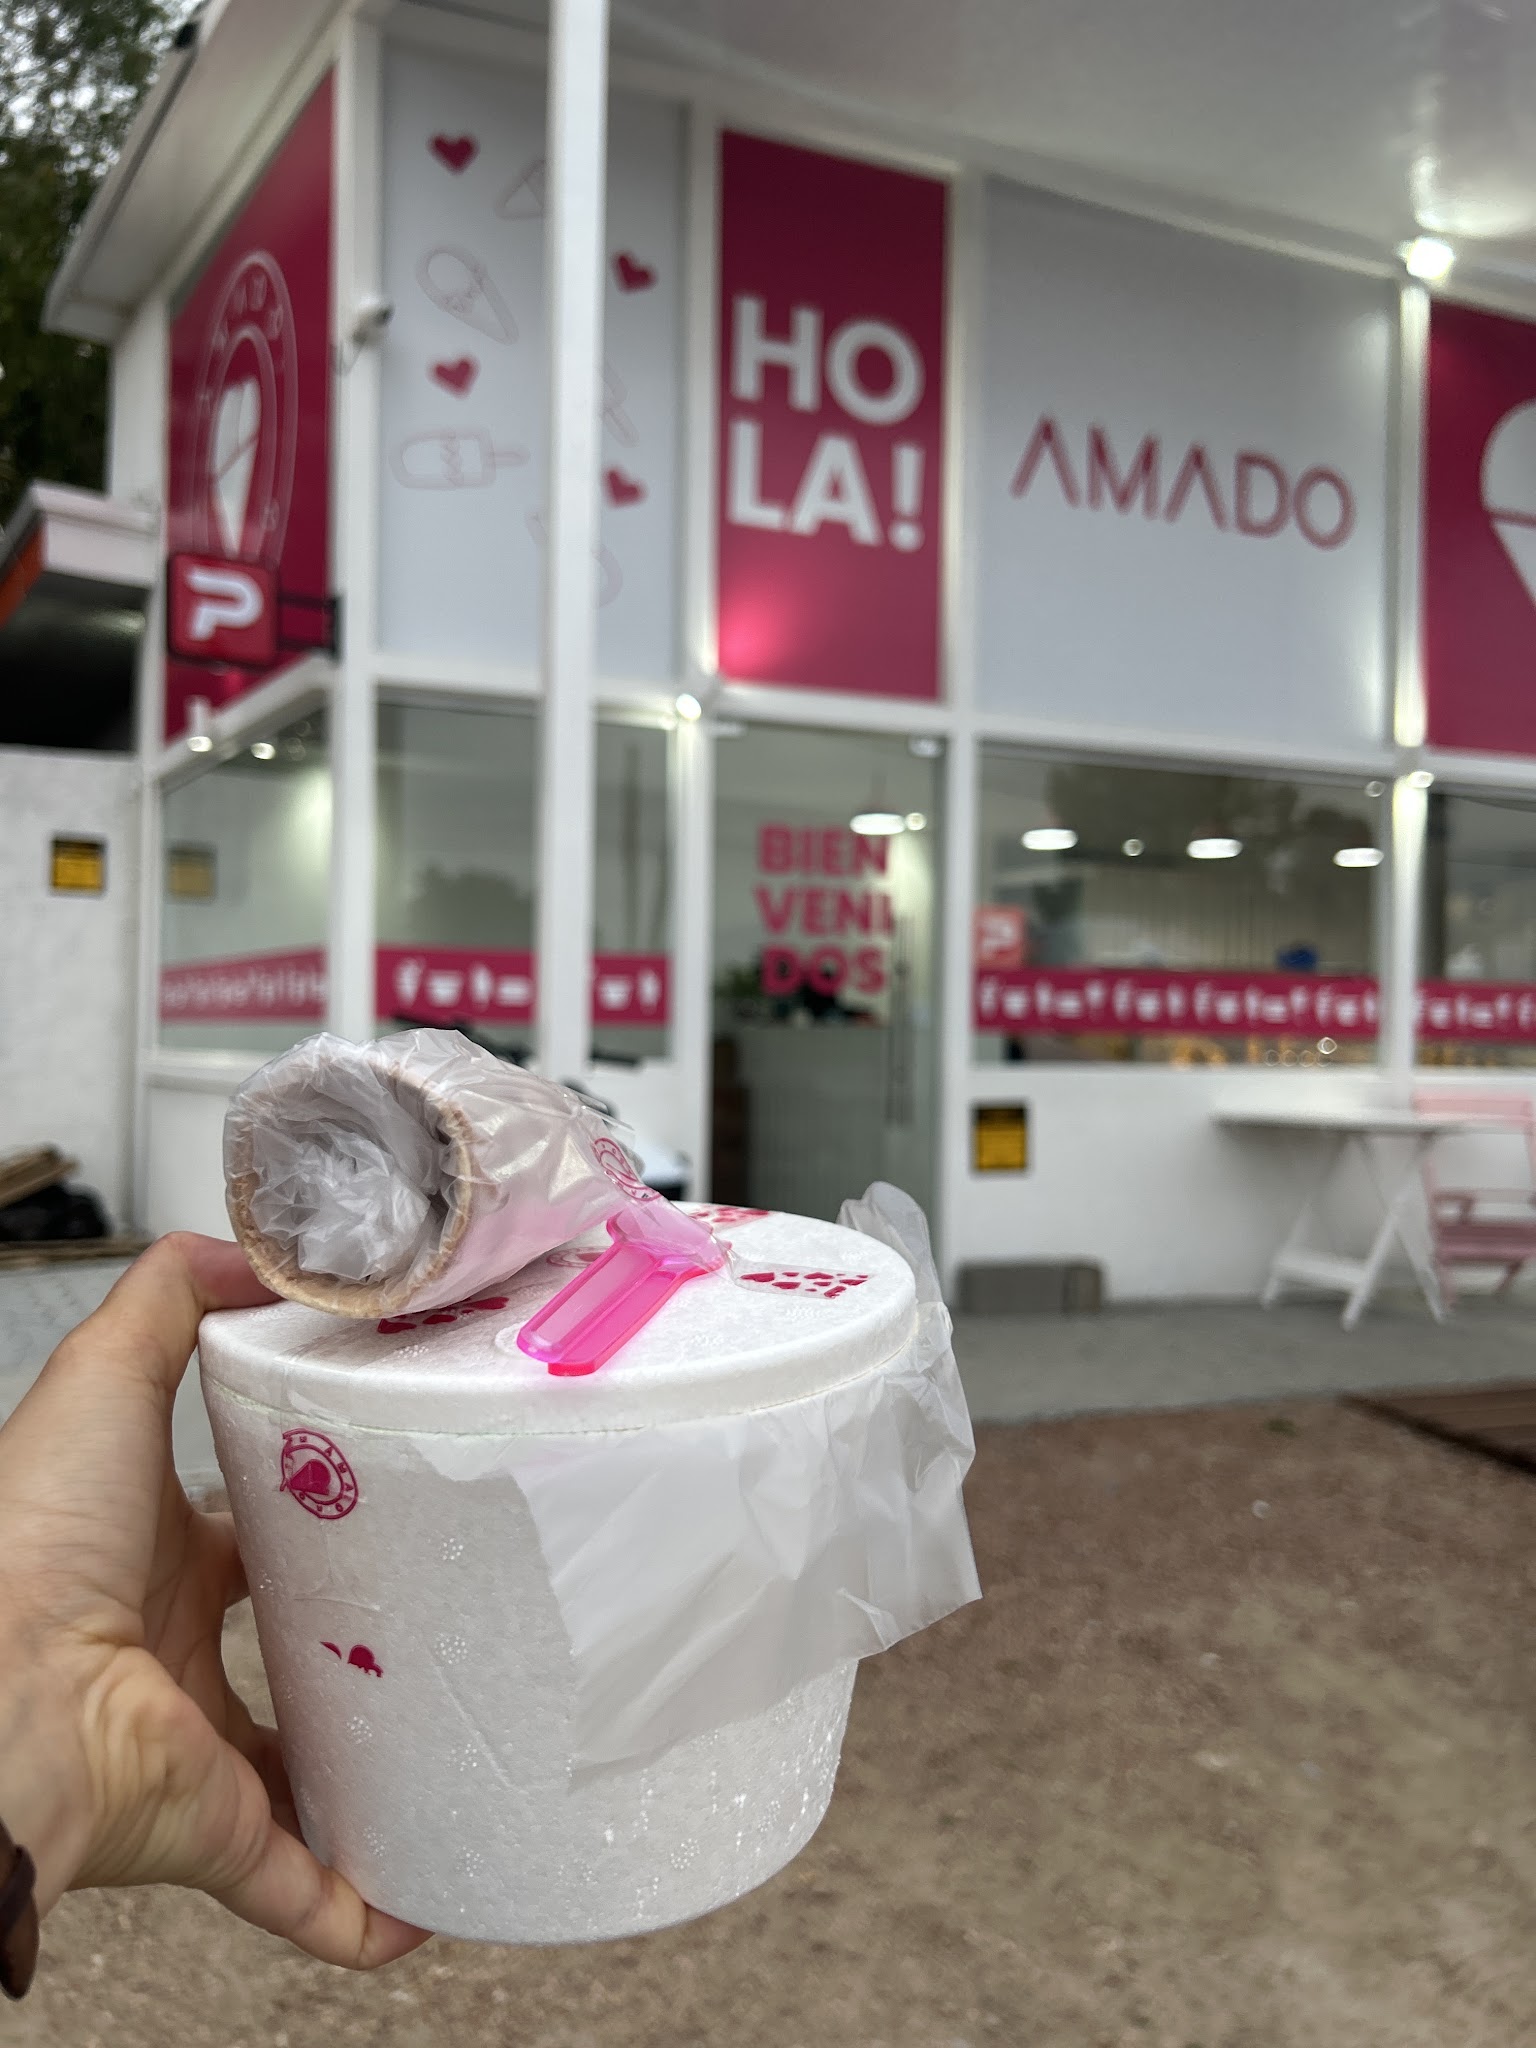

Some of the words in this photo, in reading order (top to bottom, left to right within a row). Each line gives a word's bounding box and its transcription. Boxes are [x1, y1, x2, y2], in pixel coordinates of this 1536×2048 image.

[730, 294, 926, 425] HO
[727, 418, 925, 552] LA!
[1009, 412, 1356, 549] AMADO
[759, 824, 889, 877] BIEN
[756, 886, 893, 936] VENI
[761, 945, 885, 997] DOS
